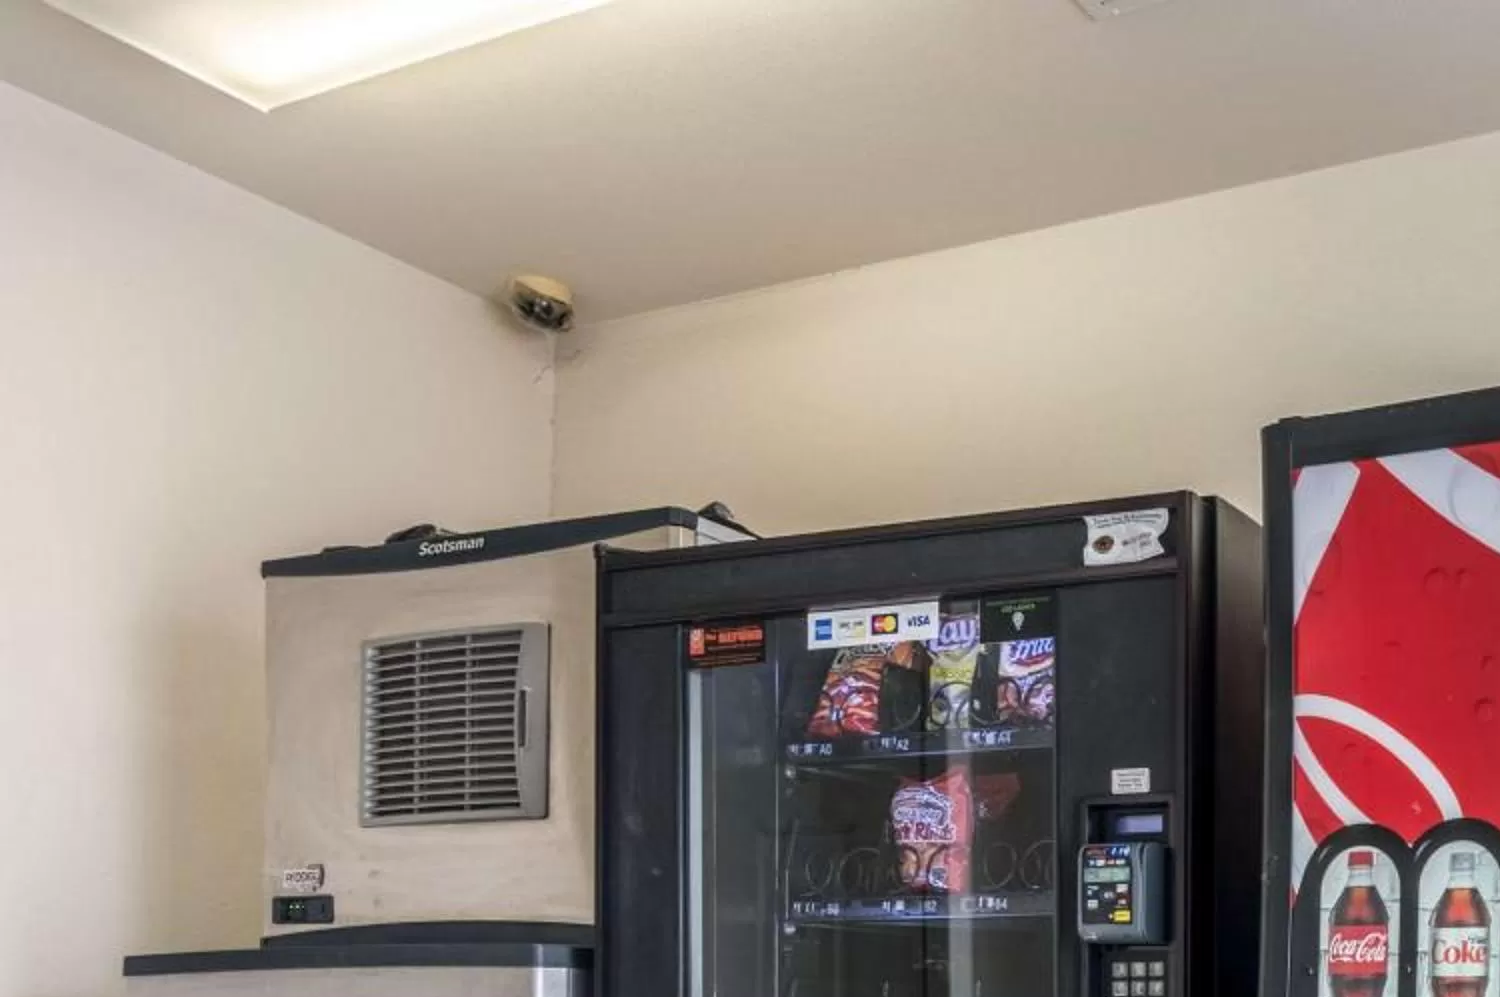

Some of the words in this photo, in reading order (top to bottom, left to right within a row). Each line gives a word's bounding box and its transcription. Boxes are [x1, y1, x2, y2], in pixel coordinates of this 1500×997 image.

[418, 537, 485, 557] Scotsman
[1329, 931, 1387, 963] Coca-Cola
[1432, 939, 1486, 964] Coke
